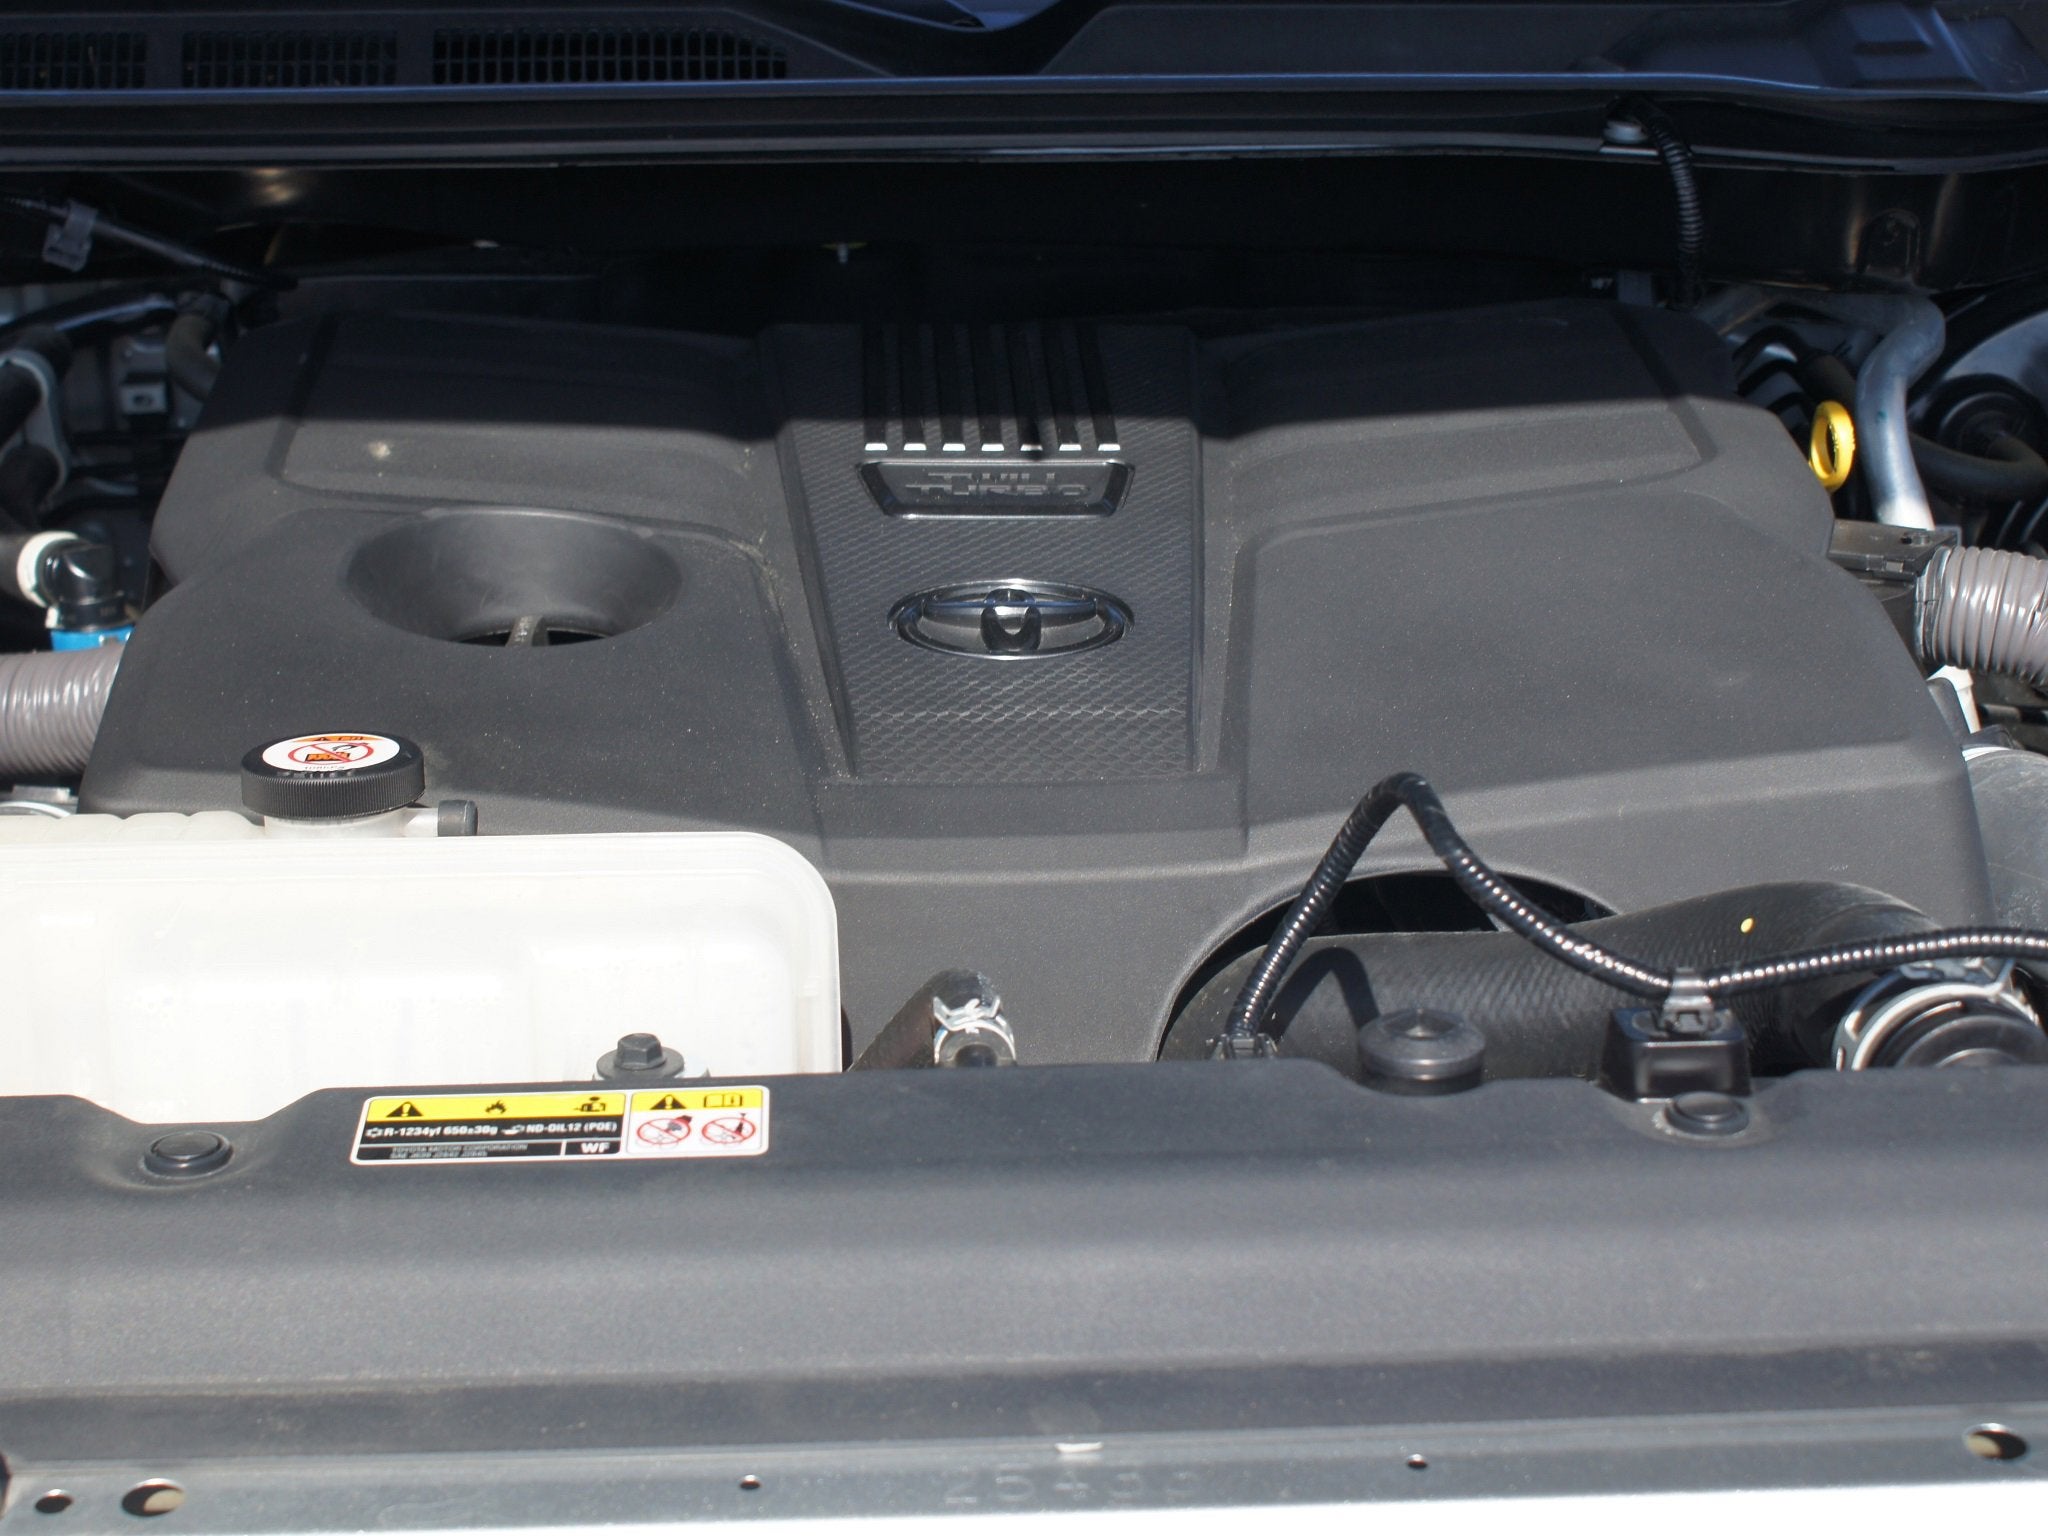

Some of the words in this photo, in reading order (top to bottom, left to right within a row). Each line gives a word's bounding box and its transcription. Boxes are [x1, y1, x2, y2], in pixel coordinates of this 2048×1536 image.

[905, 484, 1090, 496] TURBO
[583, 1121, 618, 1133] (POE)
[581, 1142, 610, 1154] WF
